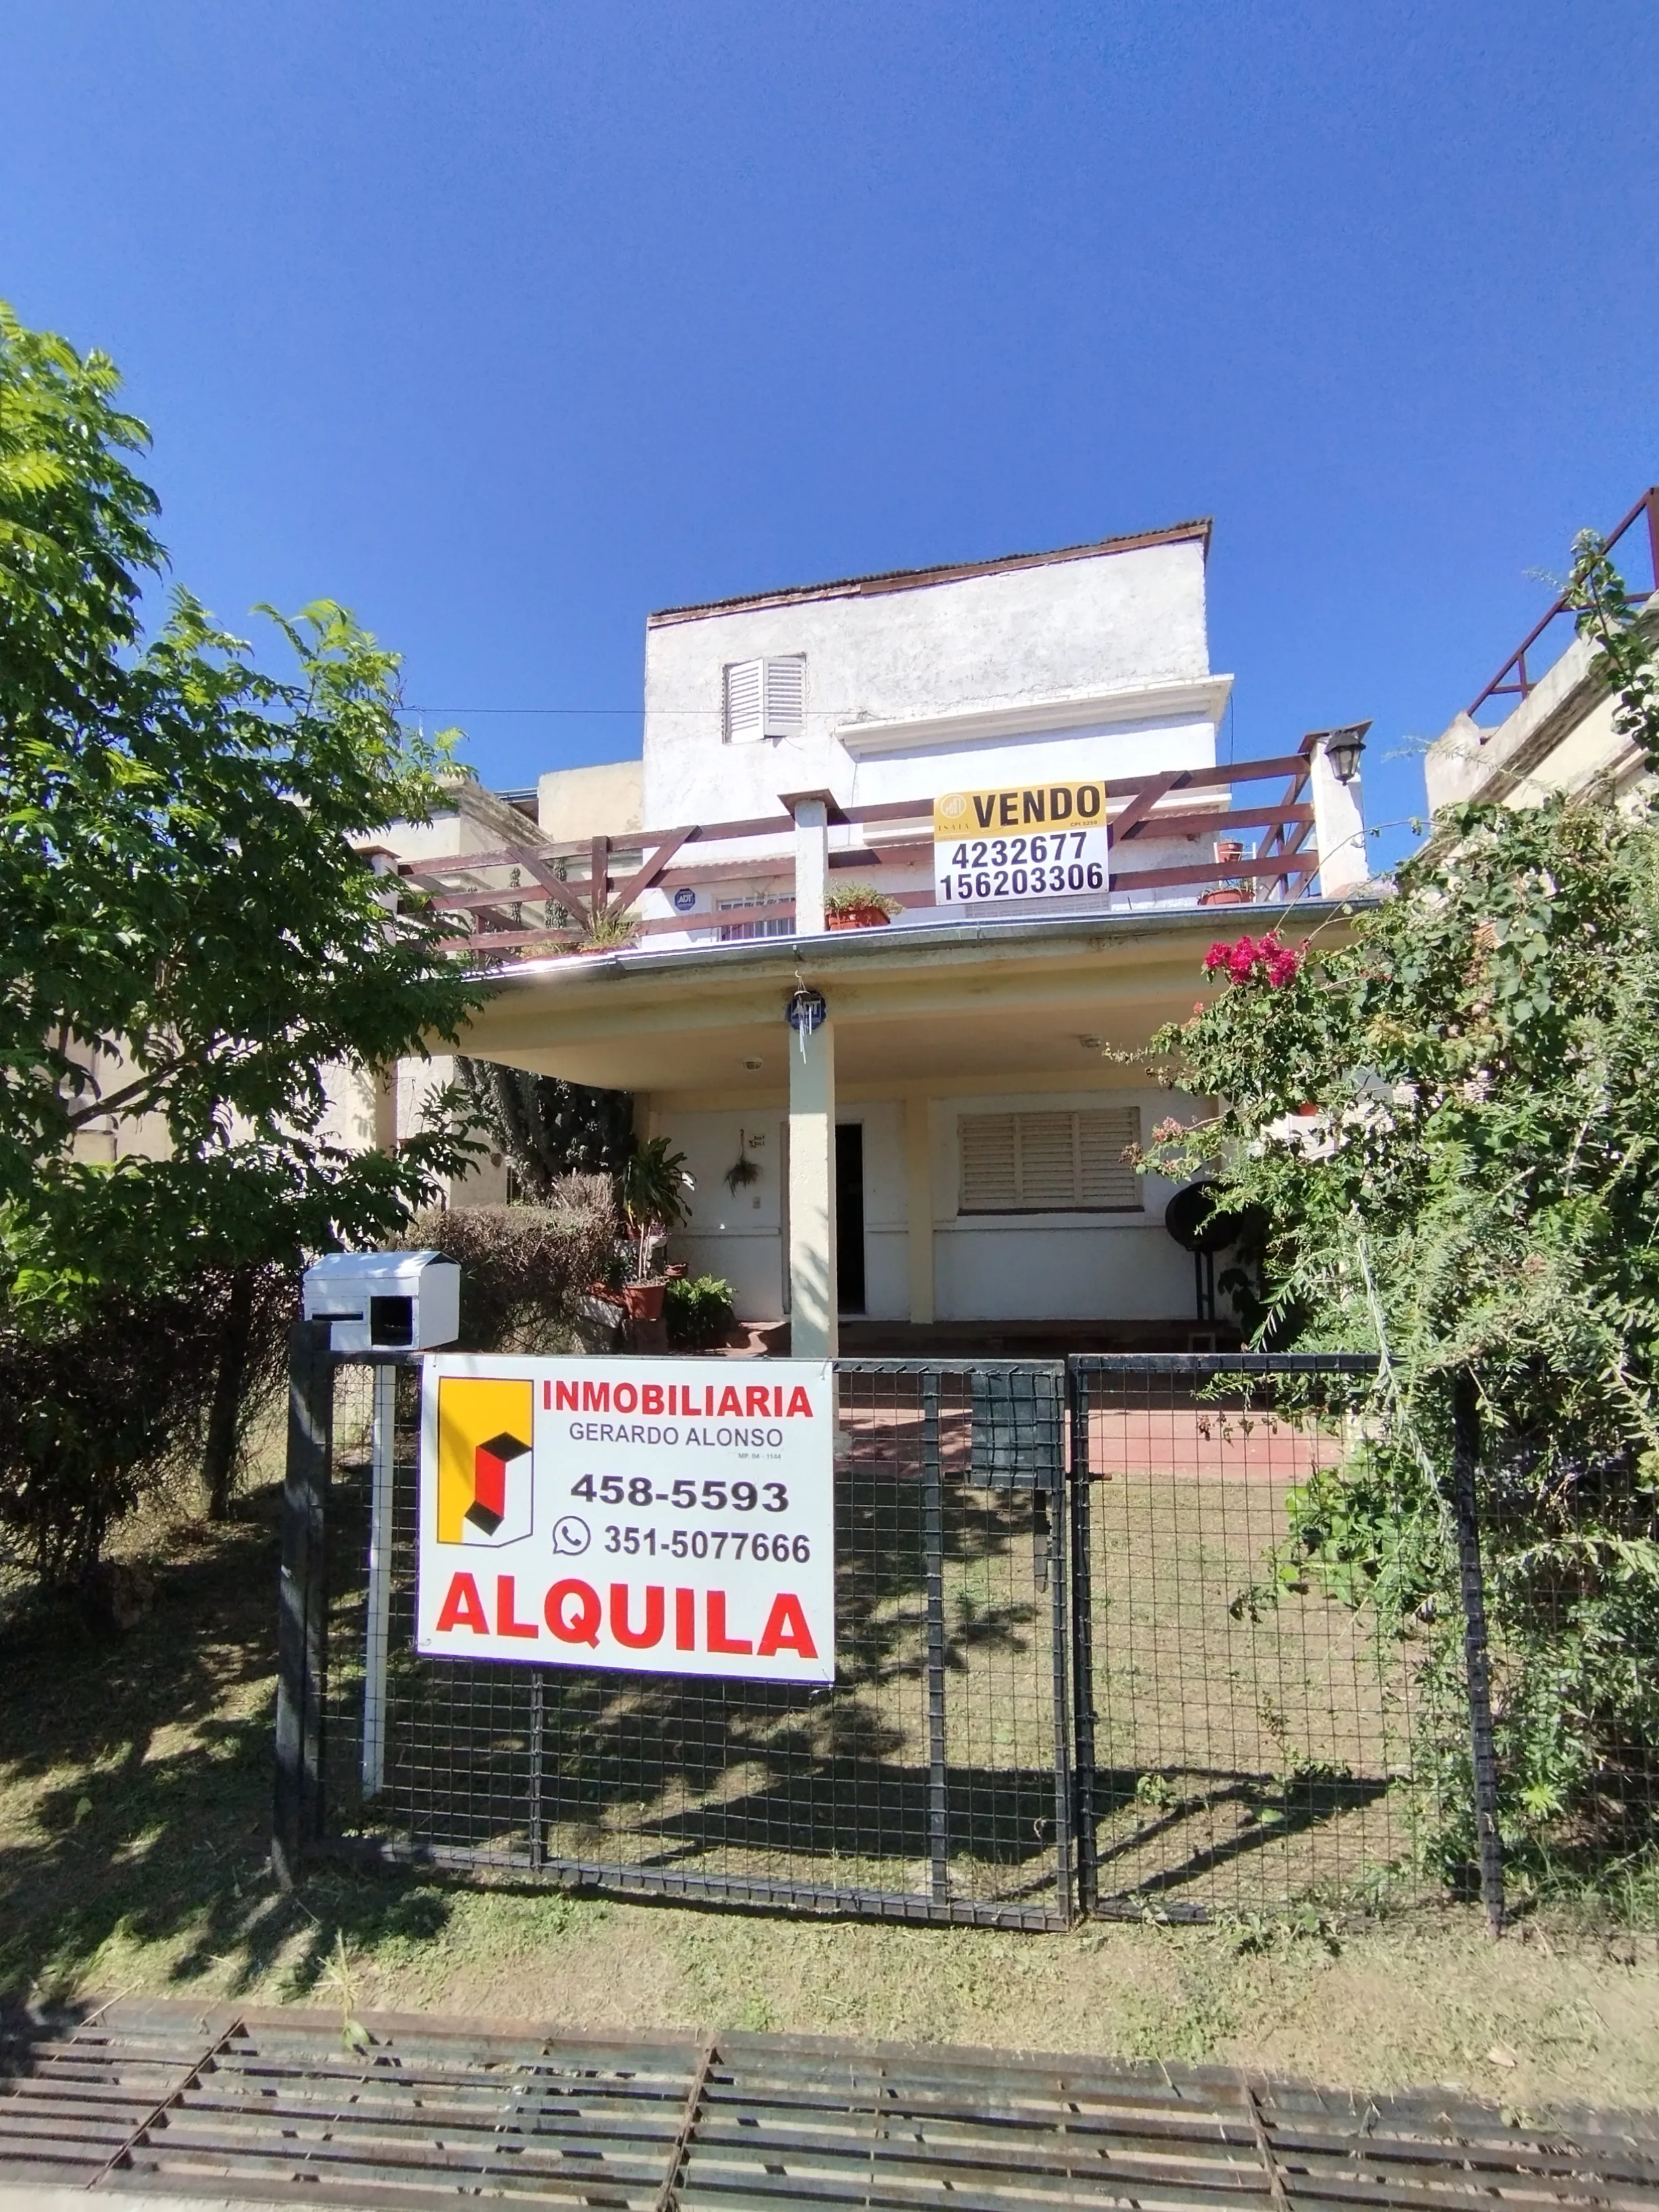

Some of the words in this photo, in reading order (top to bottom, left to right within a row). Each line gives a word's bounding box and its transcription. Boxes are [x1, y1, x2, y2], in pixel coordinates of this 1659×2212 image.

[972, 785, 1101, 828] VENDO
[951, 832, 1087, 869] 4232677
[678, 894, 693, 903] ADT
[940, 862, 1103, 901] 156203306
[544, 1380, 814, 1418] INMOBILIARIA
[569, 1422, 678, 1446] GERARDO
[685, 1427, 783, 1448] ALONSO
[571, 1473, 790, 1513] 458-5593
[605, 1525, 811, 1563] 351-5077666
[436, 1571, 819, 1659] ALQUILA
